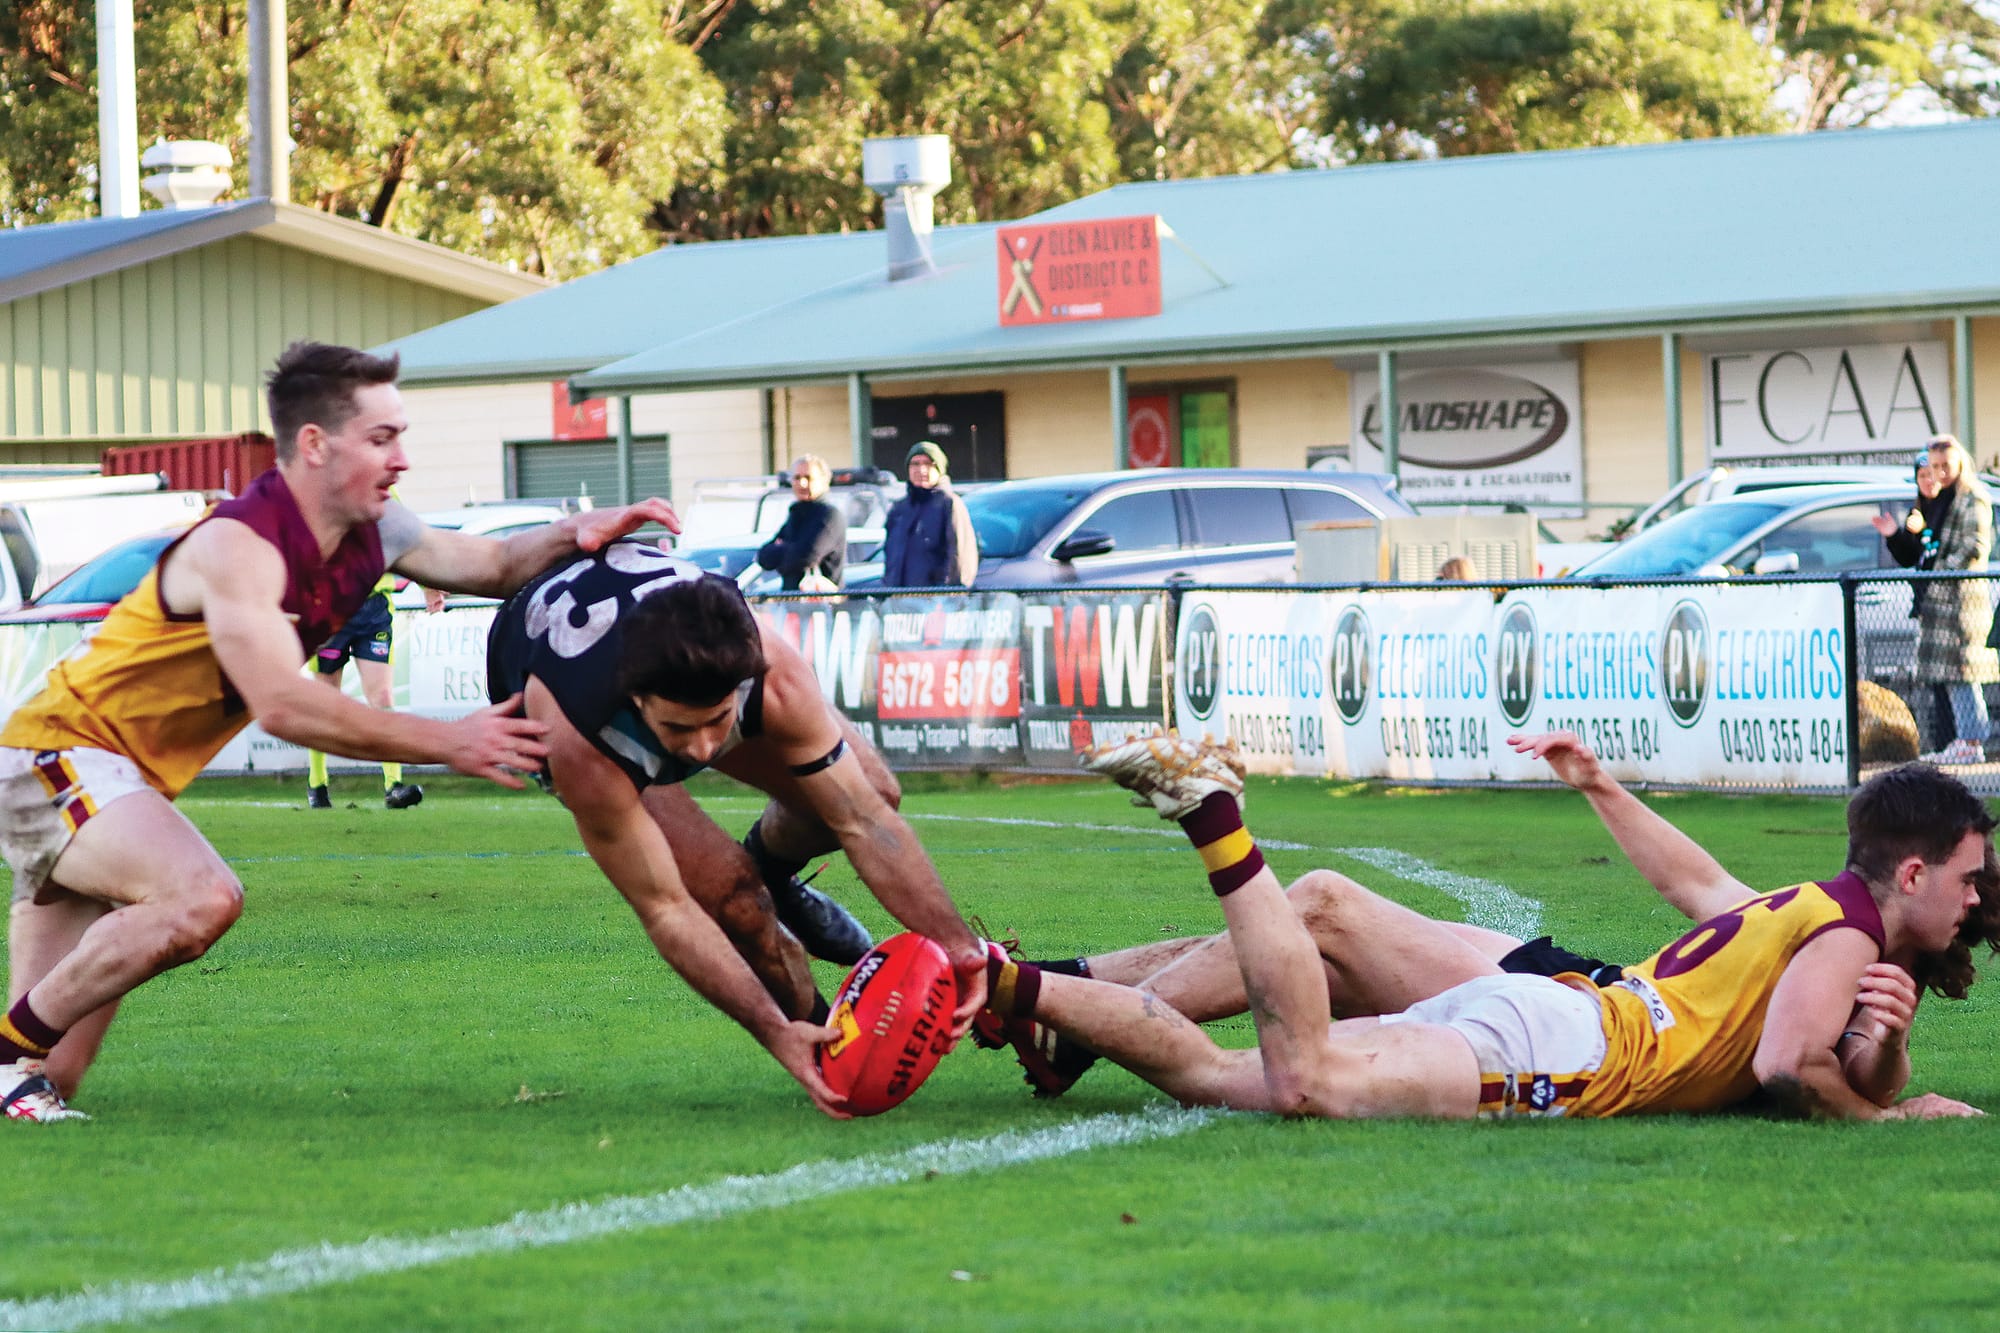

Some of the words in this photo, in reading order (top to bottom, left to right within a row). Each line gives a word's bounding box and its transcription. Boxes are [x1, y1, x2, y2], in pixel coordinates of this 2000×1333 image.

[1049, 228, 1087, 256] GLEN
[1093, 223, 1136, 251] ALVIE
[1049, 261, 1116, 291] DISTRICT
[1361, 398, 1552, 434] LNDSHAPE
[1711, 345, 1938, 447] FCAA
[443, 666, 490, 701] RES
[882, 661, 934, 708] 5672
[943, 658, 1009, 707] 5878
[1226, 632, 1323, 698] ELECTRICS
[1378, 633, 1487, 699] ELECTRICS
[1543, 631, 1655, 700] ELECTRICS
[1716, 628, 1843, 700] ELECTRICS
[1267, 715, 1294, 755] 355
[1299, 714, 1325, 757] 484
[1381, 717, 1420, 758] 0430
[1425, 716, 1453, 759] 355
[1460, 717, 1488, 759] 484
[1591, 717, 1625, 761] 355
[1719, 718, 1765, 763] 0430
[1769, 718, 1801, 762] 355
[1810, 718, 1845, 763] 484
